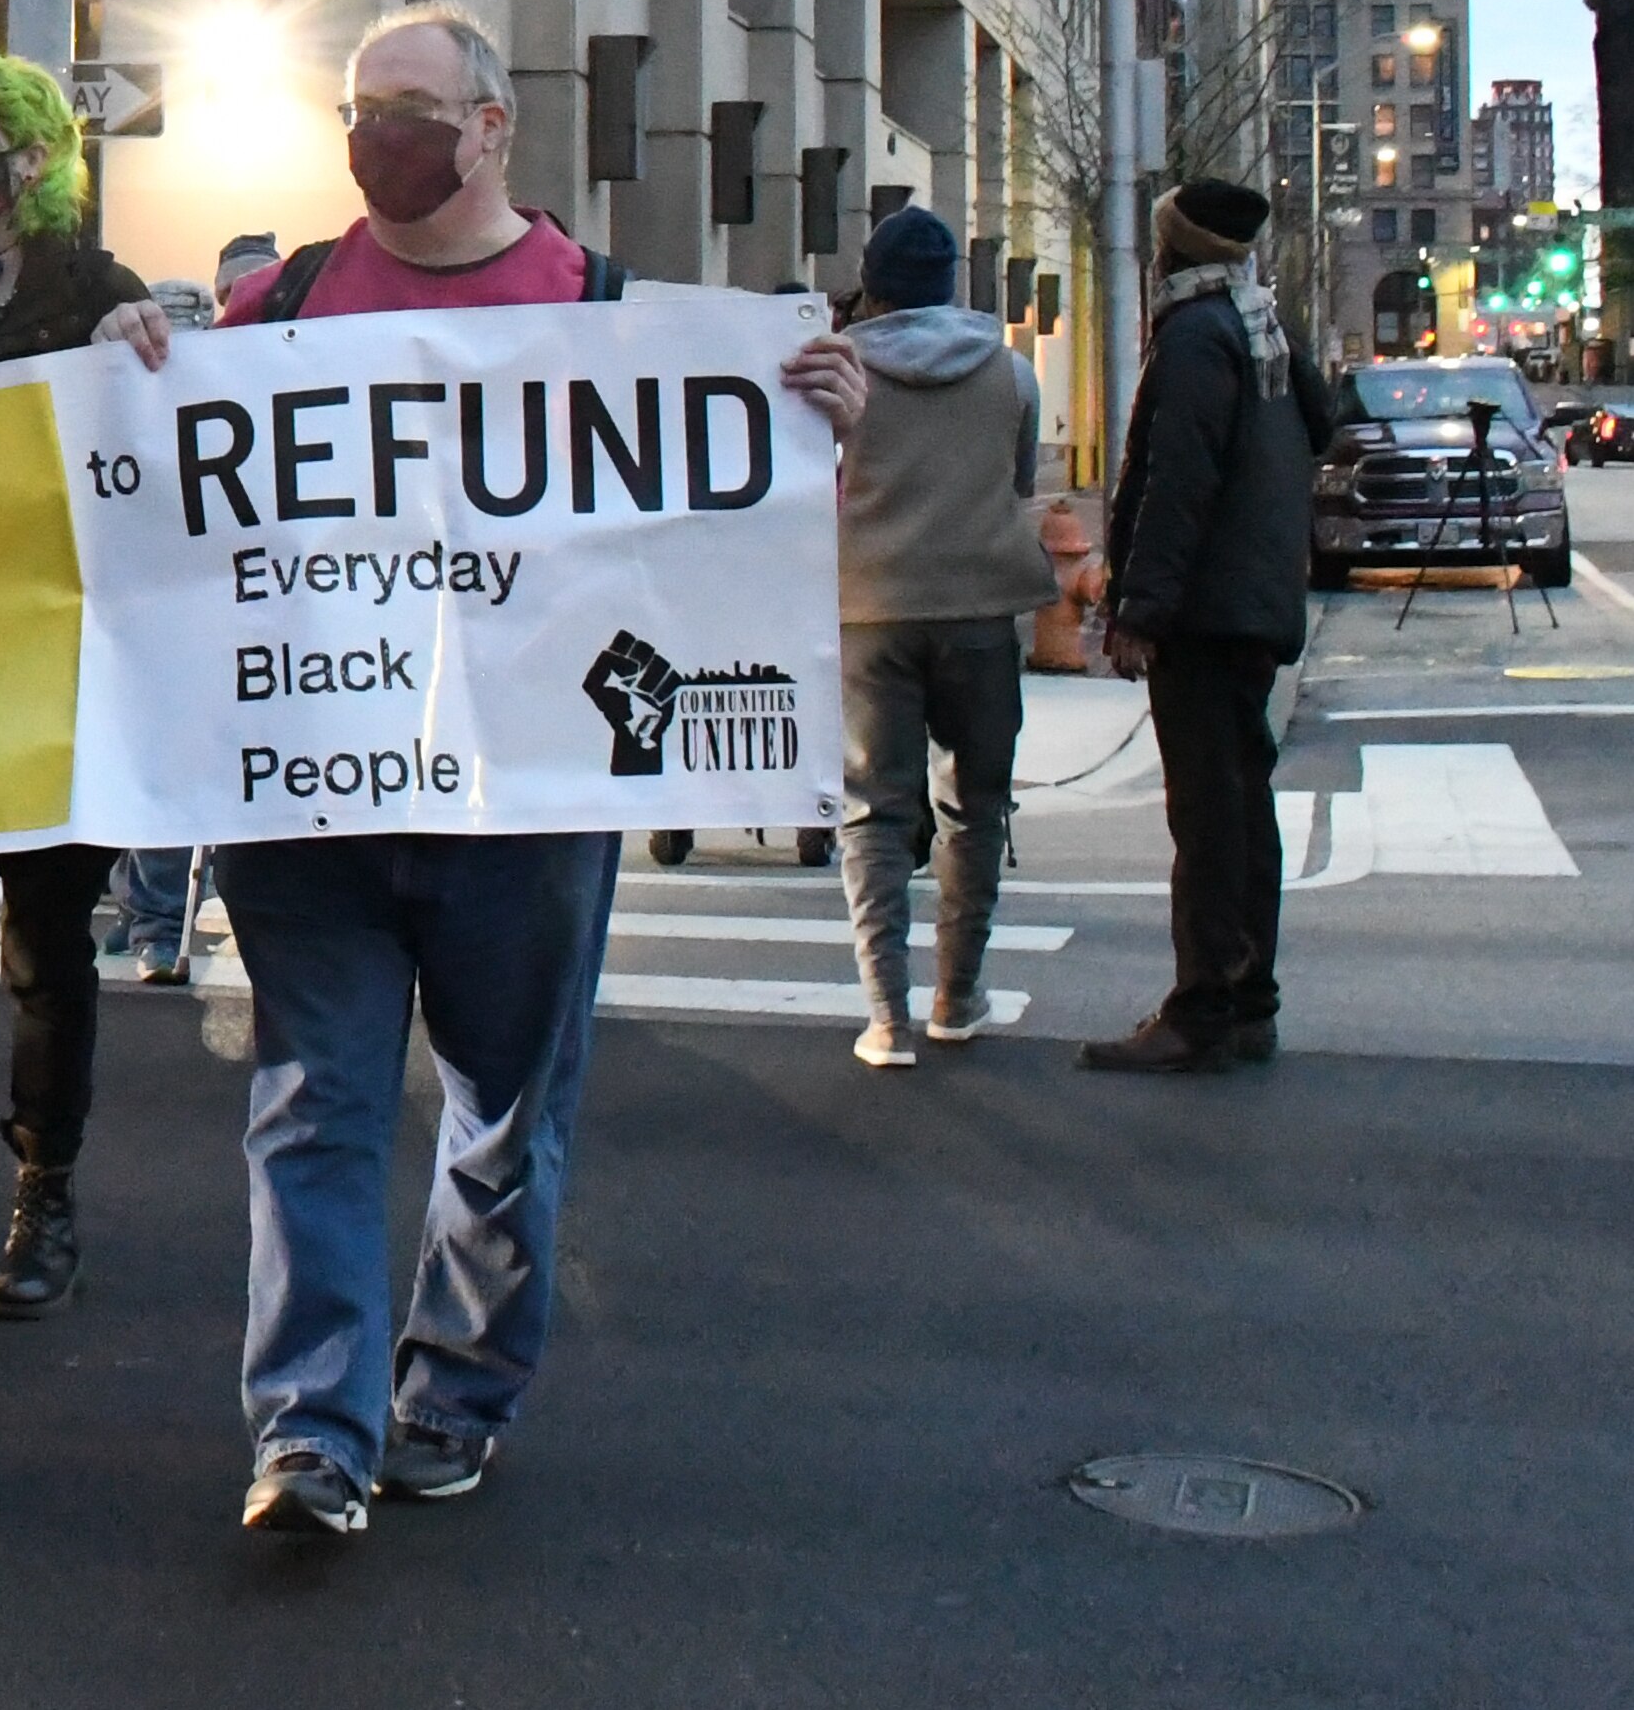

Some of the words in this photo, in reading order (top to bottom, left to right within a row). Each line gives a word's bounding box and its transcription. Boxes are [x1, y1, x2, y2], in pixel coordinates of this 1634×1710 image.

[85, 449, 142, 500] to
[175, 375, 774, 537] REFUND
[231, 541, 523, 606] Everyday
[235, 637, 418, 703] Black
[679, 688, 796, 714] COMMUNITIES
[240, 738, 461, 807] People
[681, 716, 799, 773] UNITED
